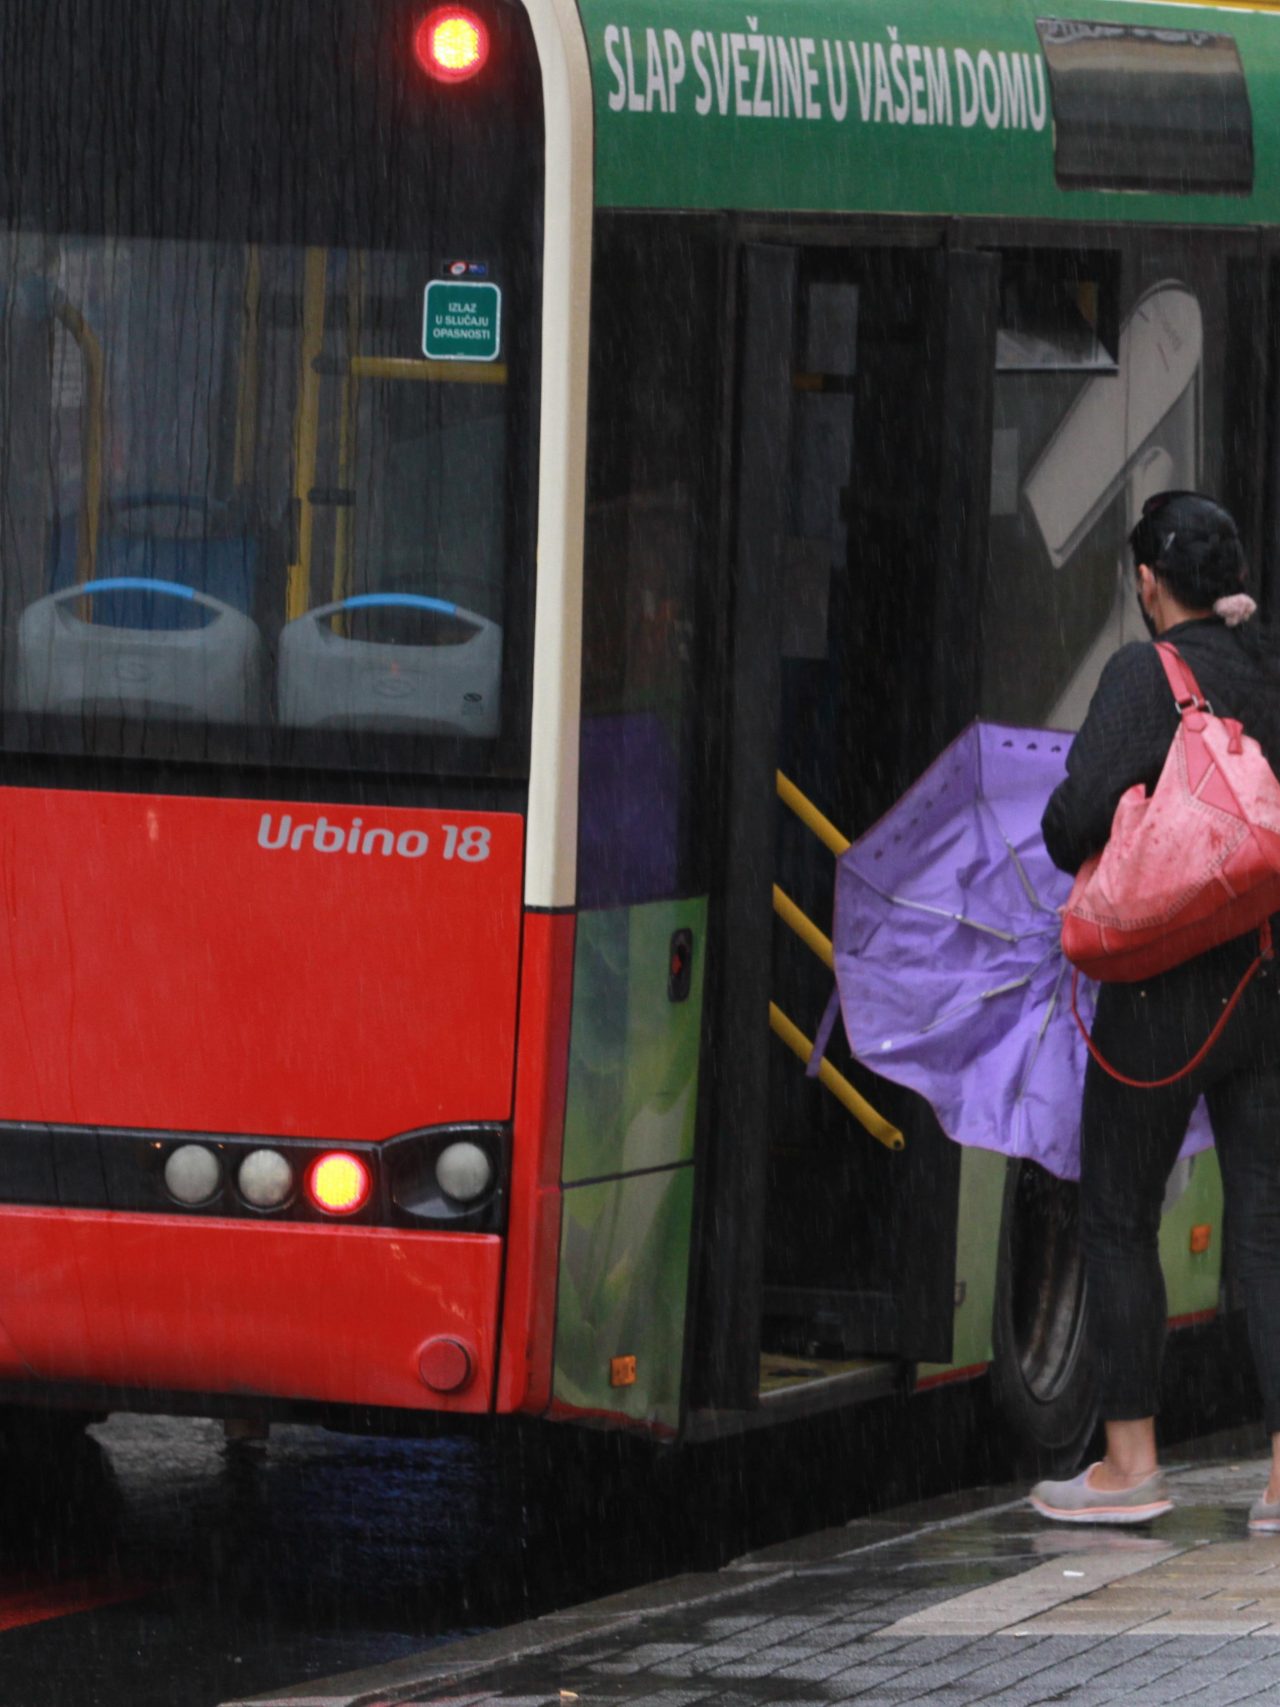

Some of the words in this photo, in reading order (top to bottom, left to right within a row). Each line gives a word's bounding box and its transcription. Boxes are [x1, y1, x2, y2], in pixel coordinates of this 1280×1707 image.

[604, 24, 686, 112] SLAP
[691, 15, 821, 119] SVEŽINE
[822, 38, 849, 122] U
[849, 25, 953, 126] VAŠEM
[954, 47, 1047, 132] DOMU
[448, 302, 477, 313] IZLAZ
[435, 315, 442, 325] U
[445, 314, 489, 327] SLUČAJU
[432, 328, 490, 340] OPASNOSTI
[257, 812, 429, 859] Urbino
[441, 824, 491, 863] 18
